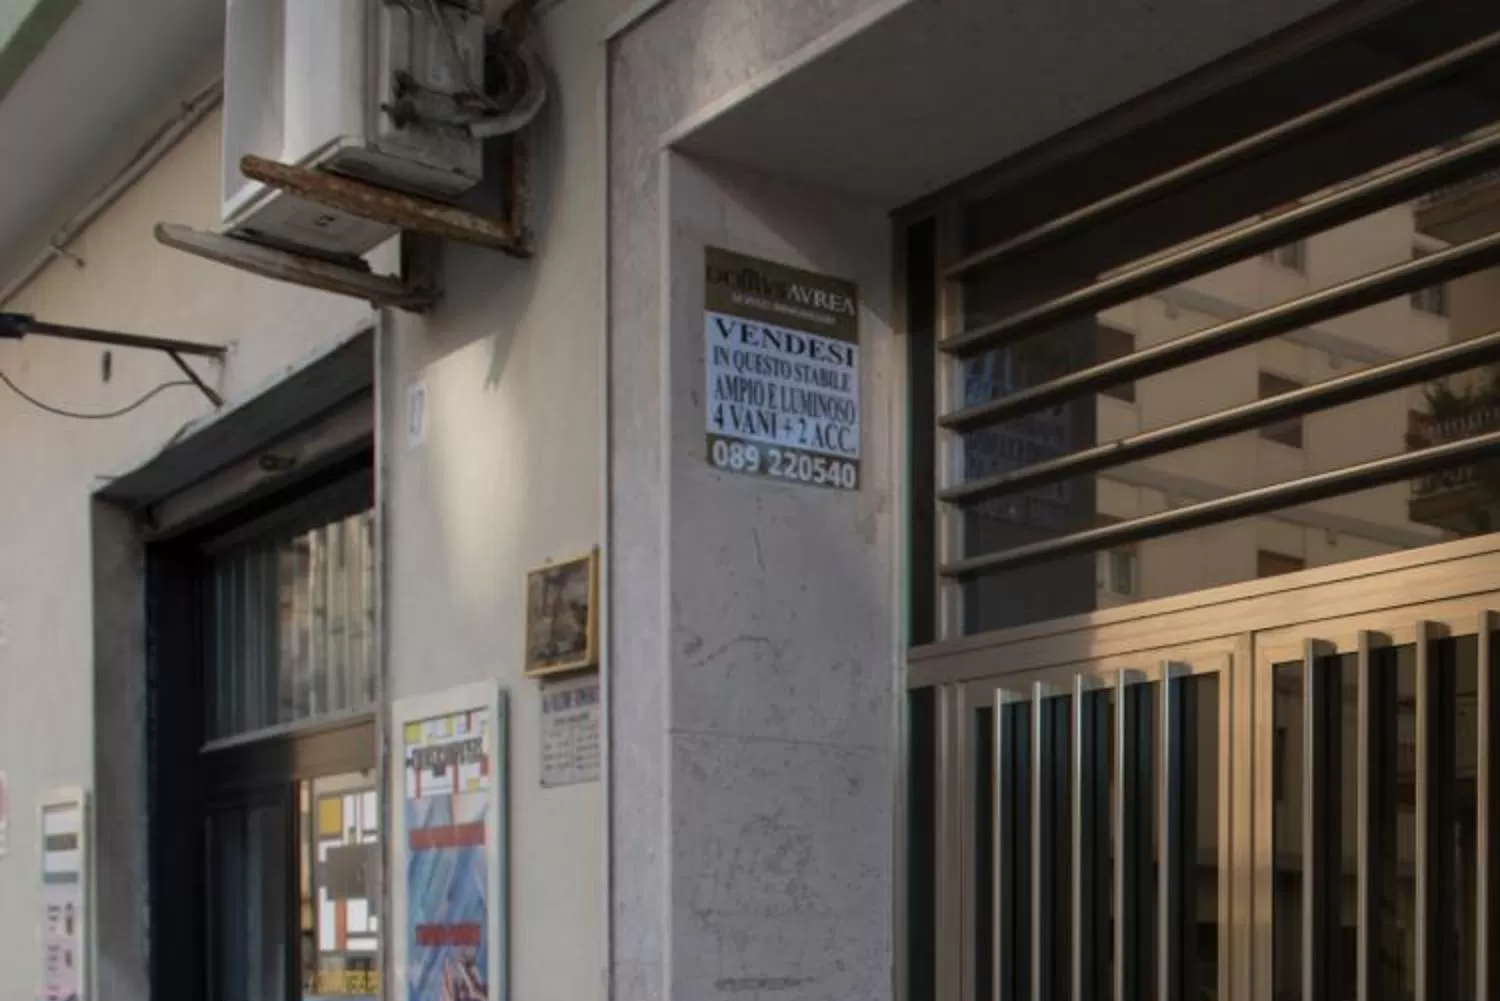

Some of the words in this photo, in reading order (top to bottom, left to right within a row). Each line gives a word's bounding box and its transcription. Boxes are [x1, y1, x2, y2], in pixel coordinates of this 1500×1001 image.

[713, 316, 855, 368] VENDESI
[713, 346, 731, 366] IN
[732, 350, 792, 380] QUESTO
[793, 364, 850, 392] STABILE
[714, 375, 765, 406] AMPIO
[767, 384, 778, 409] E
[780, 388, 856, 425] LUMINOSO
[713, 403, 724, 430] 4
[728, 405, 777, 440] VANI
[797, 418, 808, 445] 2
[813, 423, 857, 455] ACC.
[711, 439, 760, 473] 089
[767, 449, 857, 489] 220540
